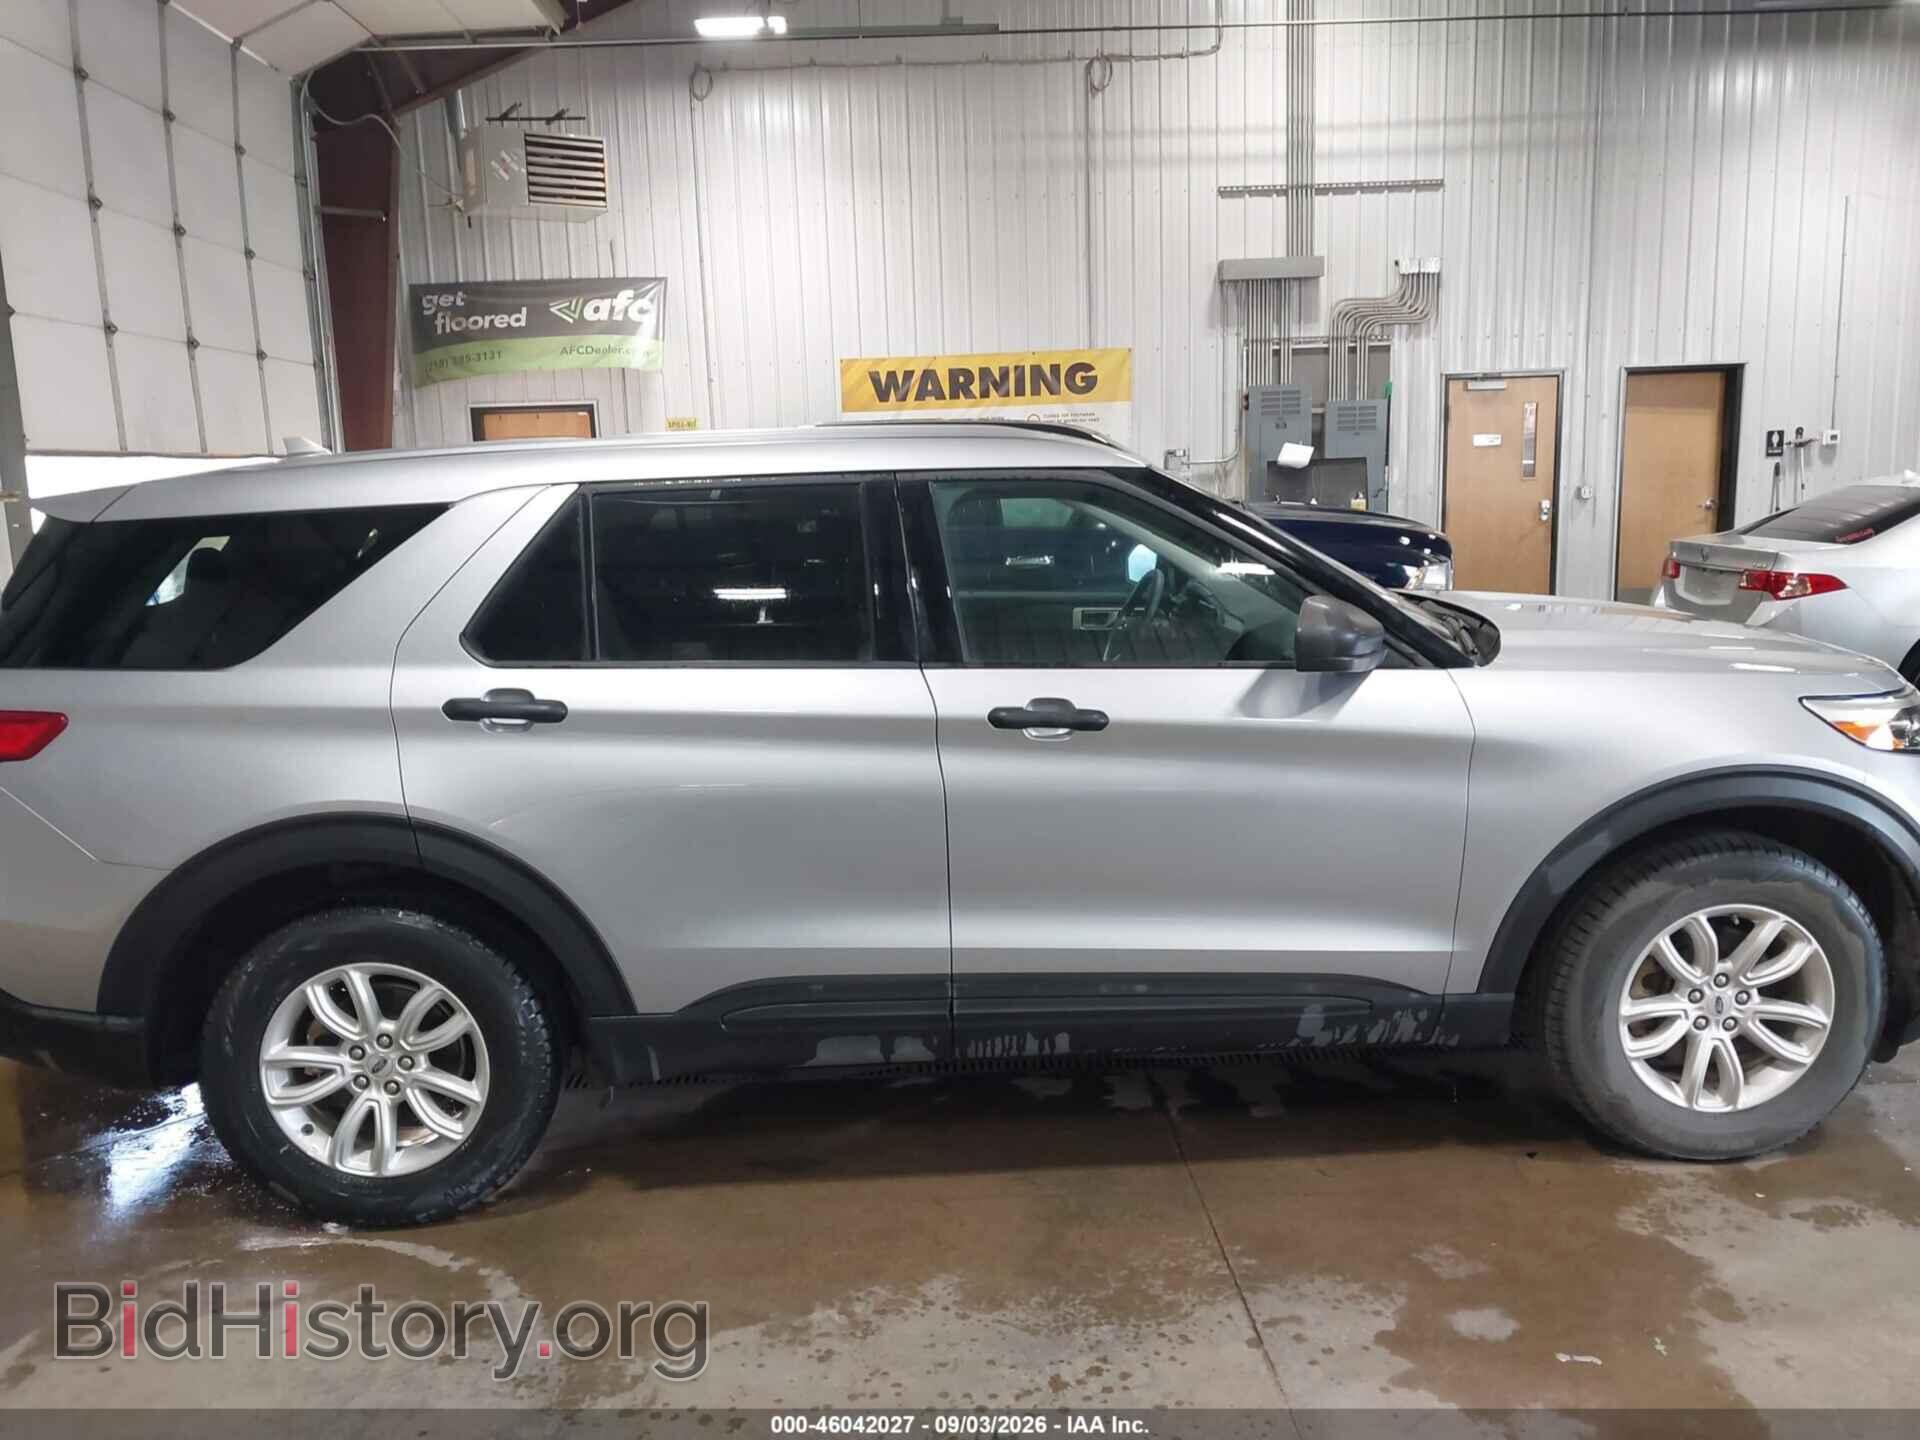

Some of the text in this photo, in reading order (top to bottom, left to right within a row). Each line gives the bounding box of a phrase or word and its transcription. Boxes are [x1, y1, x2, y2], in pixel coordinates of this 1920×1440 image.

[421, 291, 466, 316] get
[583, 289, 655, 322] afc
[435, 306, 528, 335] floored
[868, 361, 1099, 403] WARNING
